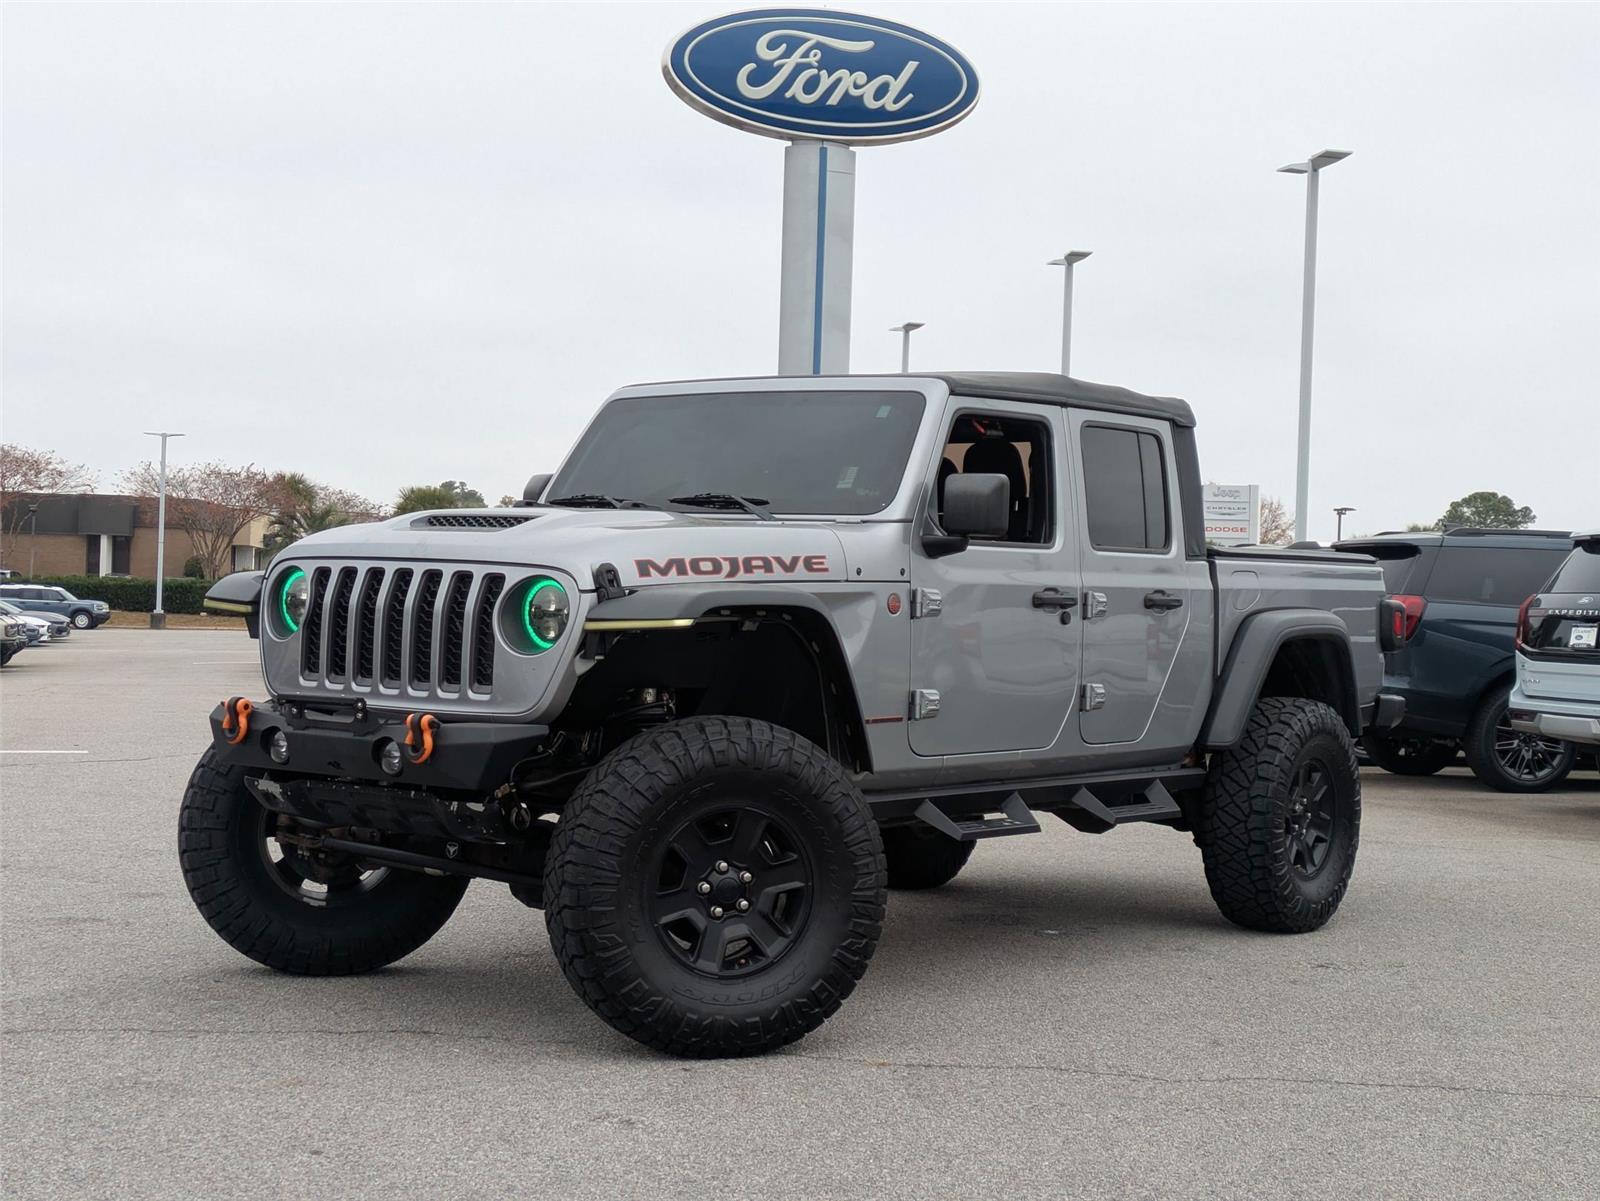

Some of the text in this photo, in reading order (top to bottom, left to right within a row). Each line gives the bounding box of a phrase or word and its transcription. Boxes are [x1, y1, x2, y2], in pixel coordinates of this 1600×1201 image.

[736, 29, 921, 112] Ford
[1212, 486, 1241, 500] Jeep
[633, 554, 830, 579] MOJAVE
